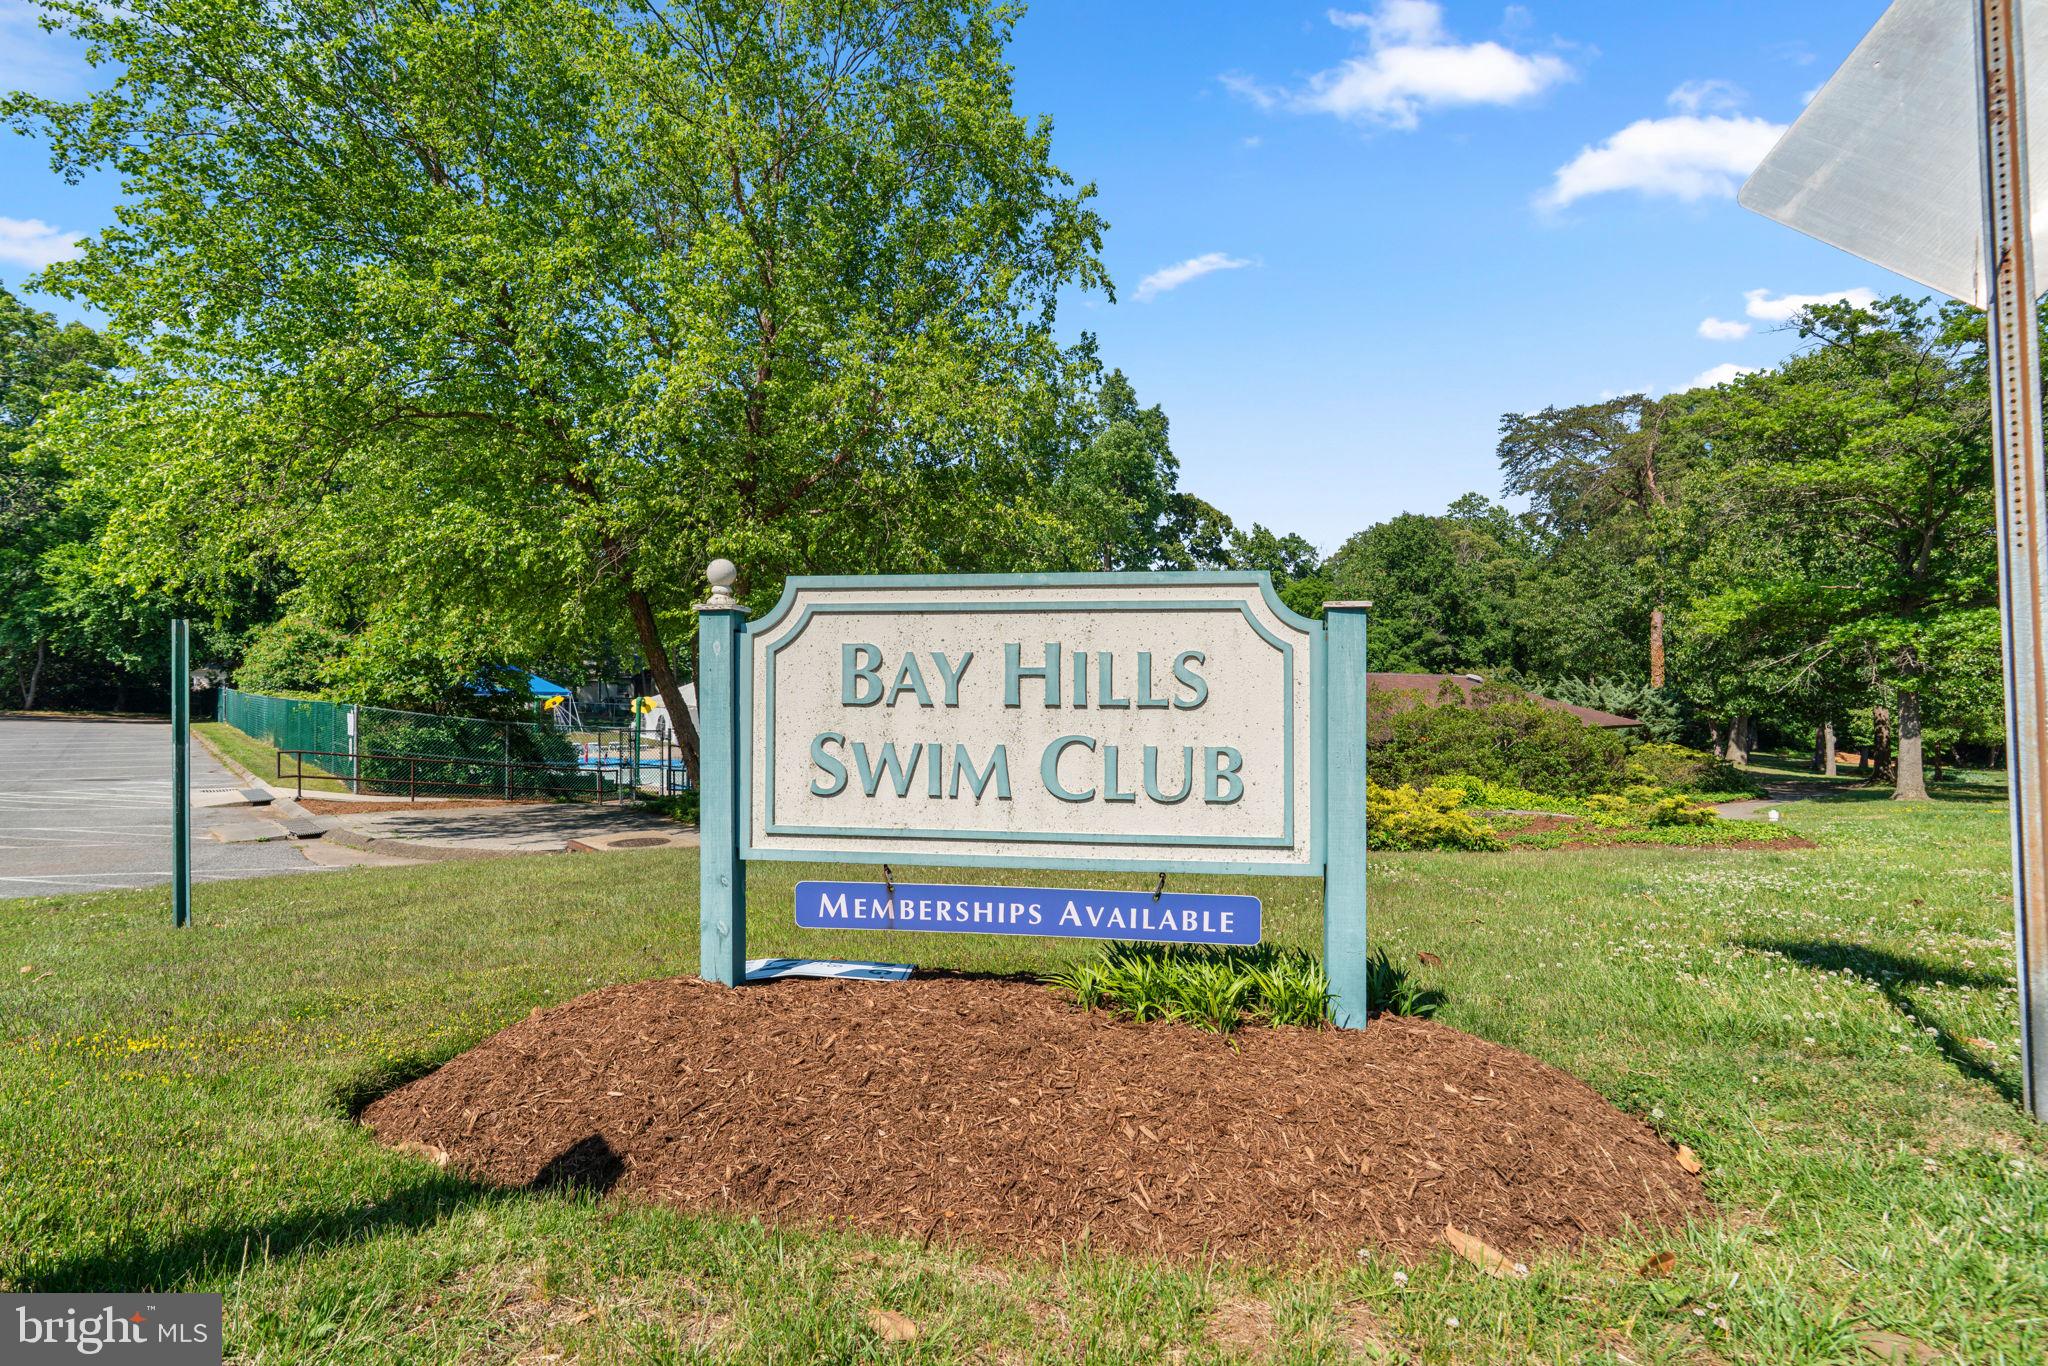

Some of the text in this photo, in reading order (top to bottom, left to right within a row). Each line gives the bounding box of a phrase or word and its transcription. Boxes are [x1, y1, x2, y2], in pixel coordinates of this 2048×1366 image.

[841, 642, 1209, 709] BAY HILLS
[810, 731, 1245, 805] SWIM CLUB
[818, 892, 1235, 935] MEMBERSHIPS AVAILABLE
